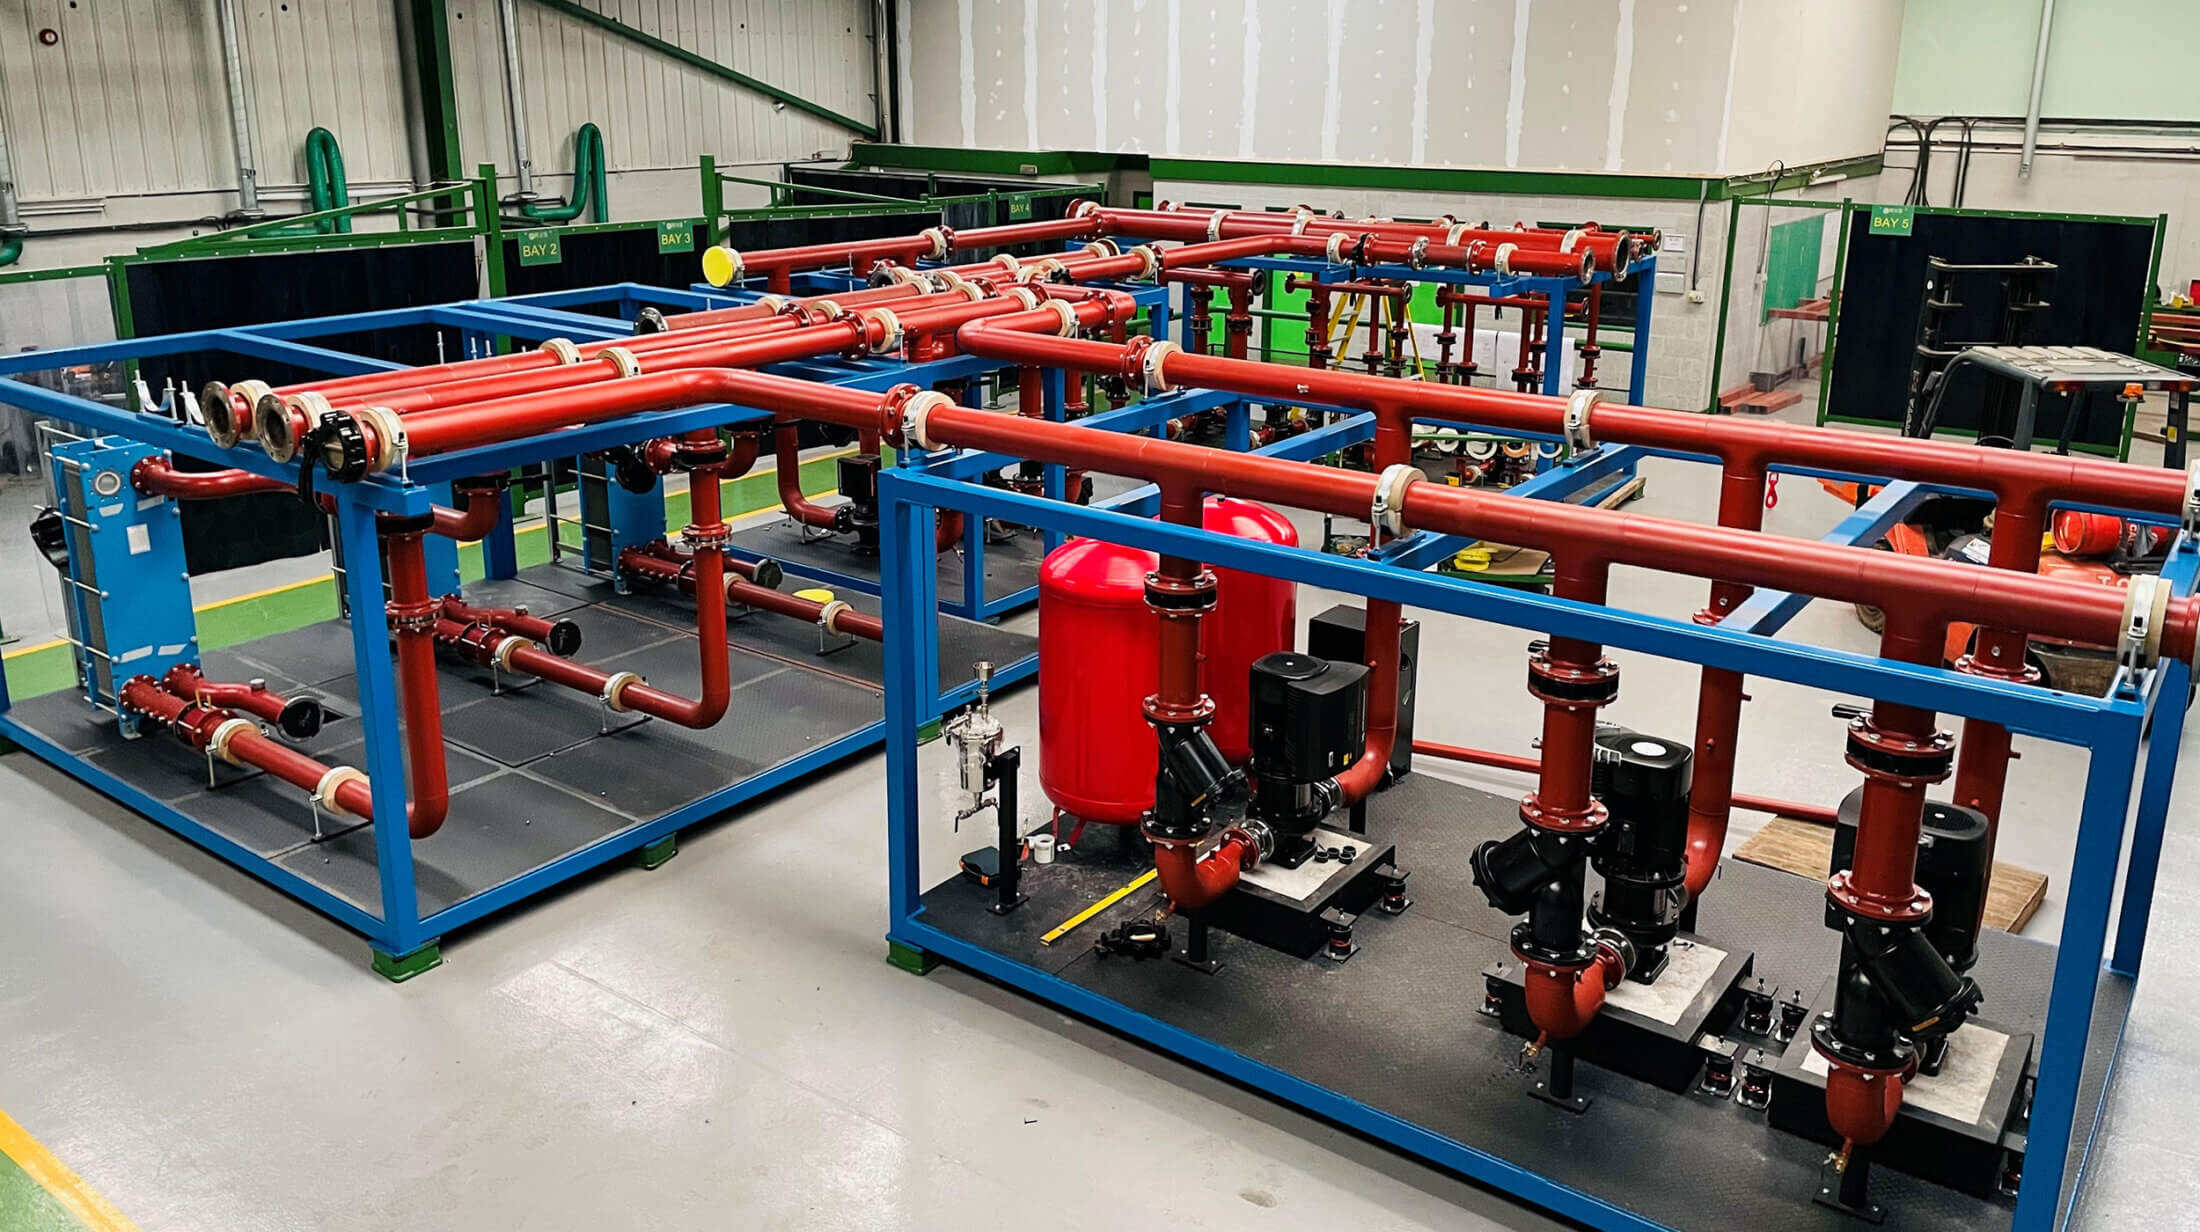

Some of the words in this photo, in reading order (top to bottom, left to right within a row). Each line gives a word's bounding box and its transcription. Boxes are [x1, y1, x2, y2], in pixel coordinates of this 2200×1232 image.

[1010, 204, 1024, 213] BAY
[1873, 217, 1899, 228] BAY
[1901, 218, 1909, 229] 5
[661, 233, 681, 245] BAY
[684, 232, 691, 244] 3
[522, 244, 546, 257] BAY
[550, 243, 557, 255] 2
